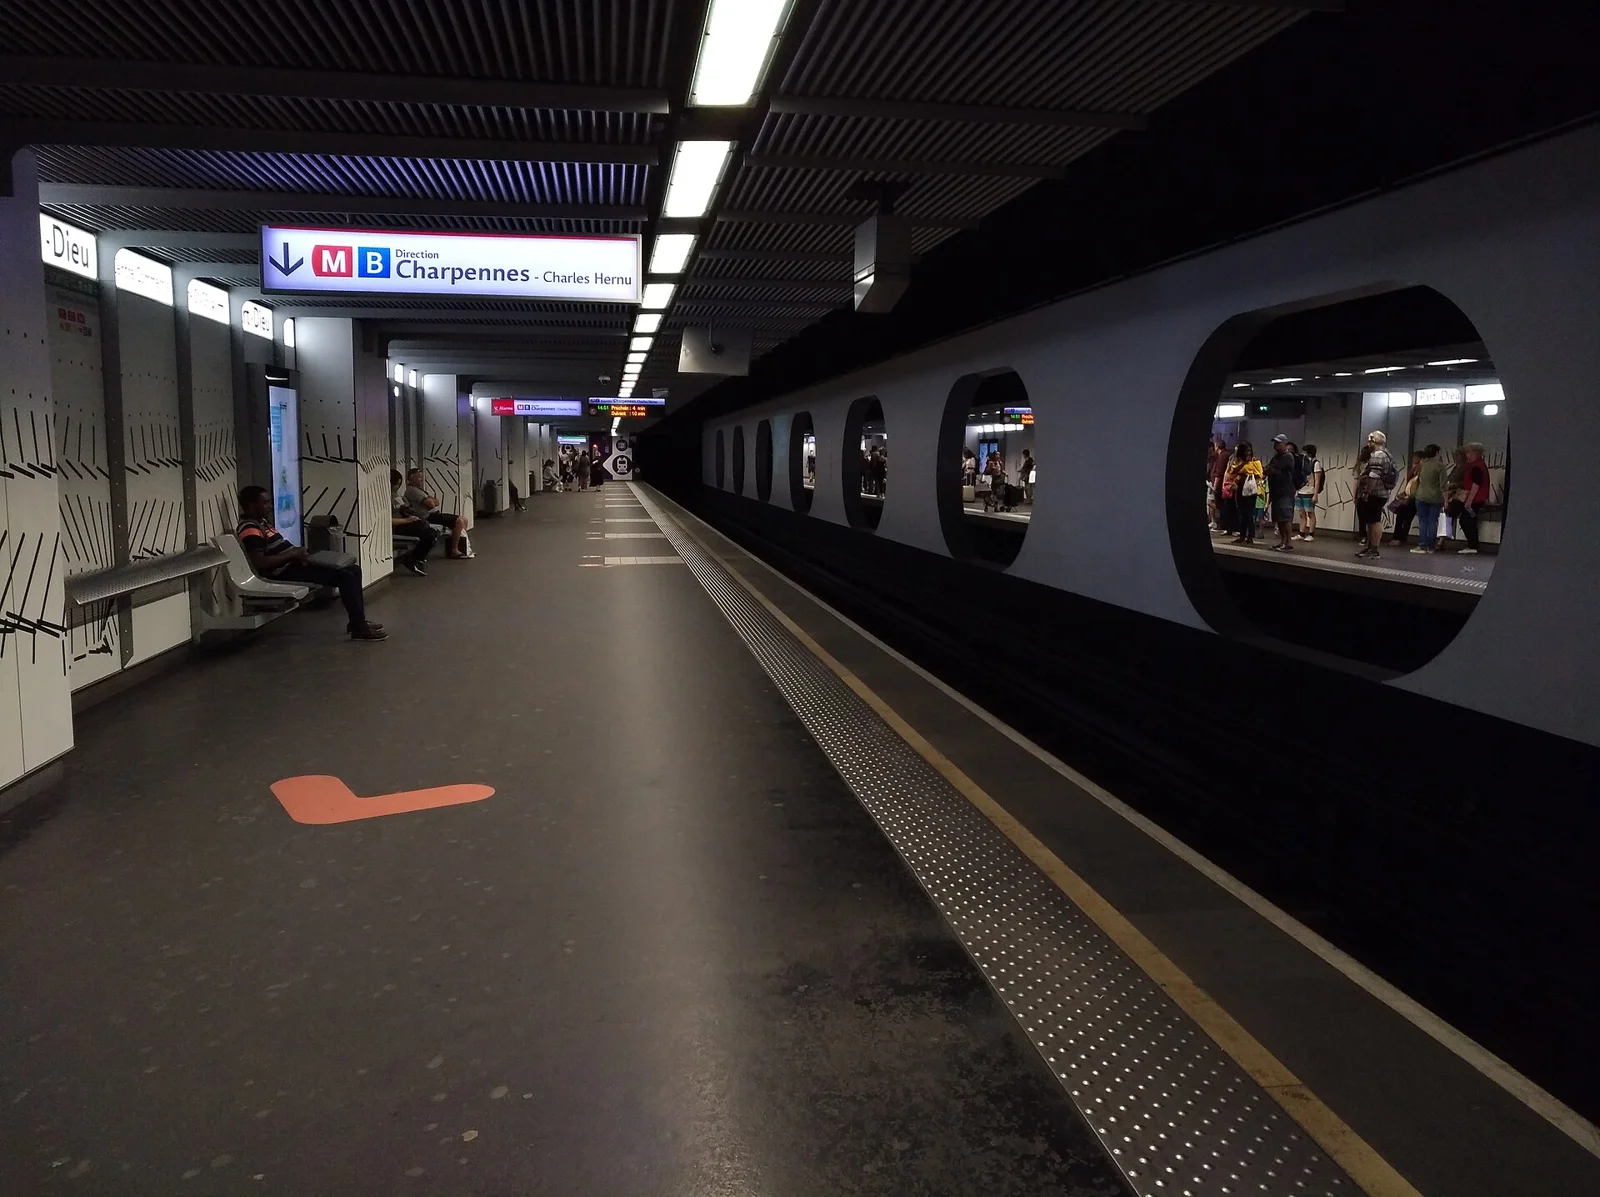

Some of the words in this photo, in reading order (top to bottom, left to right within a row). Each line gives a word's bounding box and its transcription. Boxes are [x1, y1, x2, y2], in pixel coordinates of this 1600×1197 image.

[321, 249, 348, 274] M
[366, 251, 384, 274] B
[395, 249, 440, 260] Direction
[395, 259, 530, 285] Charpennes
[543, 270, 590, 285] Charles
[594, 272, 632, 286] Hernu
